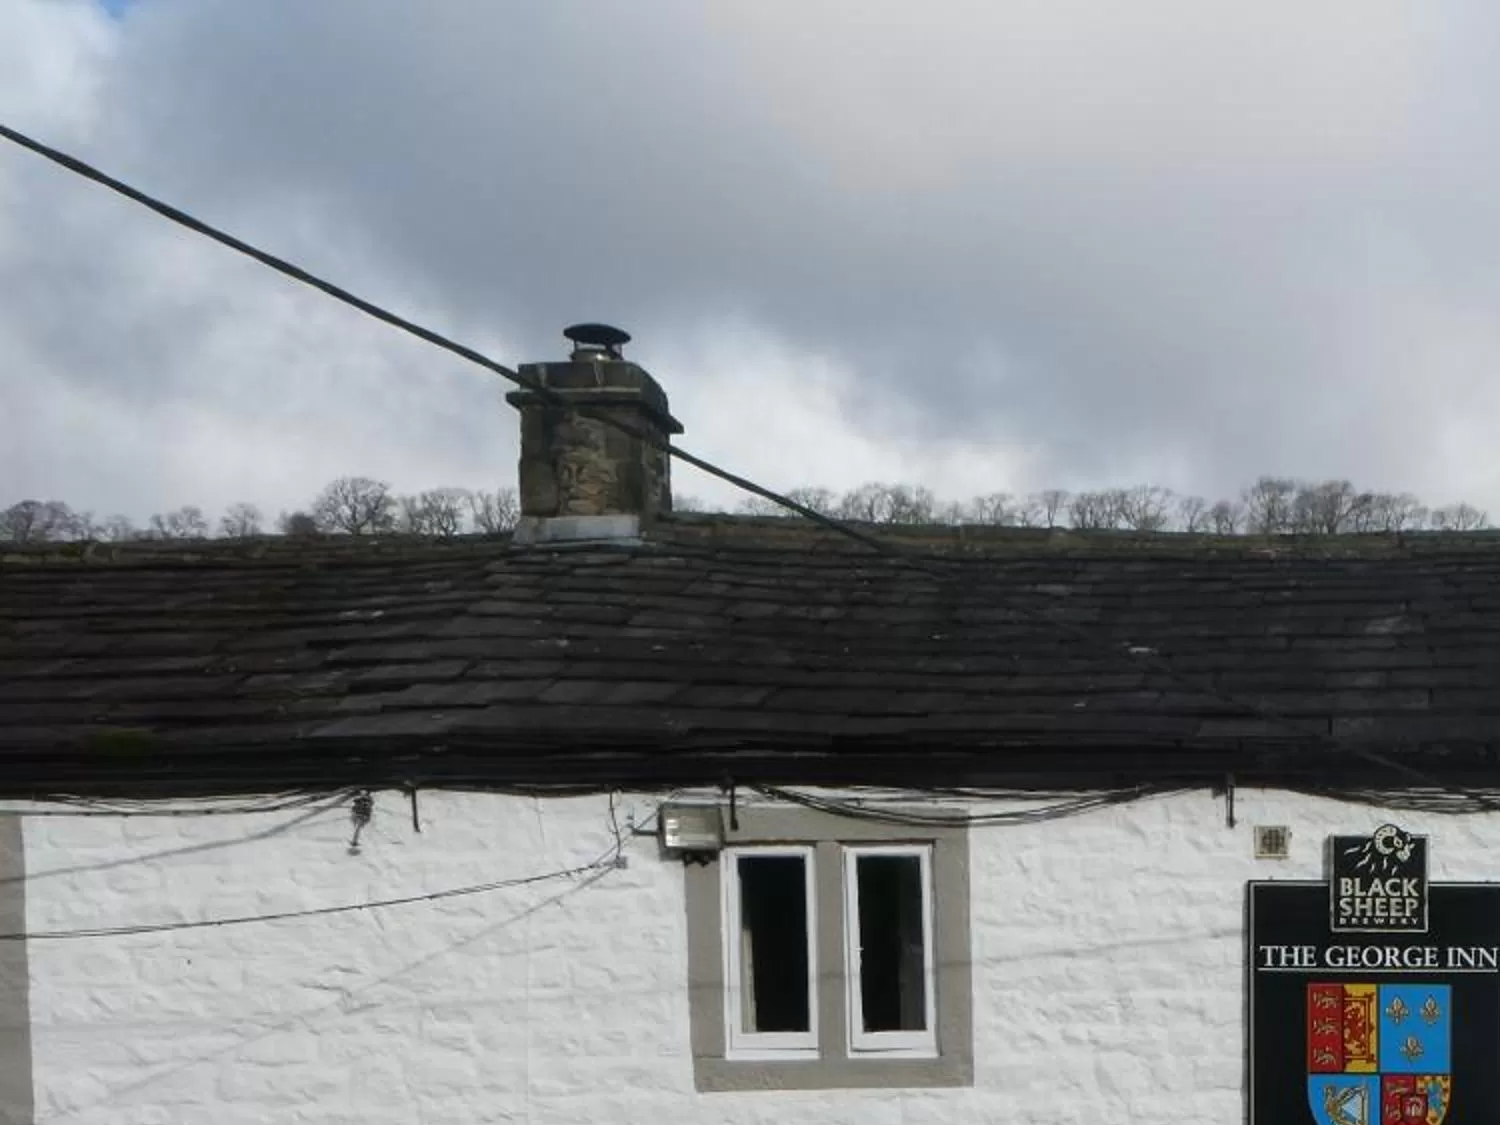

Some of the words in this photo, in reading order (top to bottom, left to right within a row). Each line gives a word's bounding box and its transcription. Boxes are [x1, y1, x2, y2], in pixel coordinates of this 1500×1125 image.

[1339, 877, 1419, 897] BLACK
[1339, 898, 1419, 917] SHEEP
[1339, 917, 1419, 925] BREWERY
[1259, 945, 1317, 968] THE
[1325, 945, 1439, 968] GEORGE
[1447, 946, 1499, 968] INN
